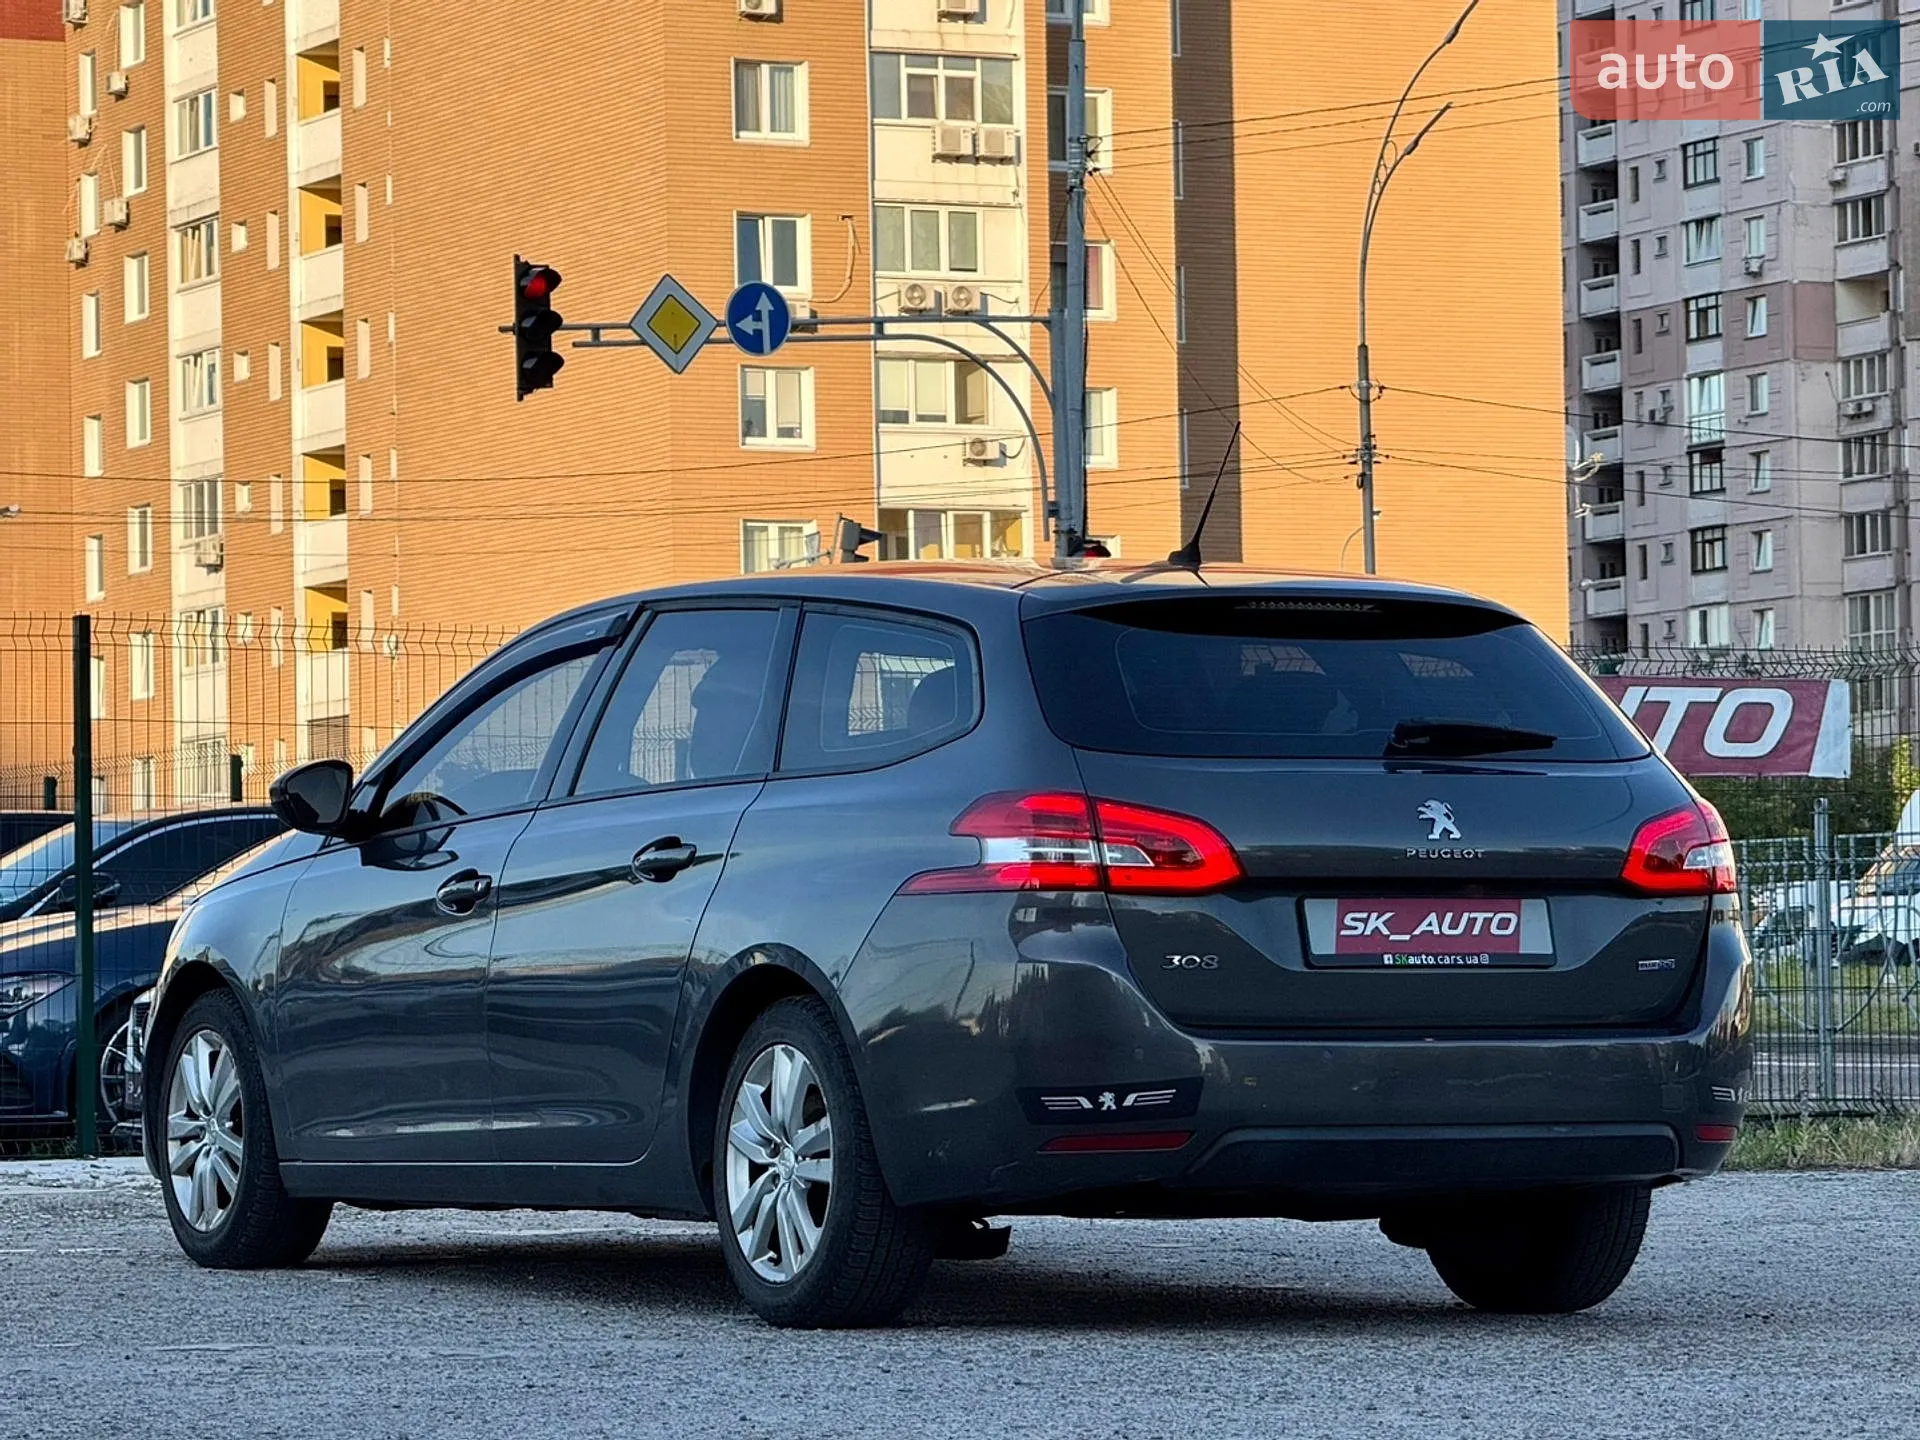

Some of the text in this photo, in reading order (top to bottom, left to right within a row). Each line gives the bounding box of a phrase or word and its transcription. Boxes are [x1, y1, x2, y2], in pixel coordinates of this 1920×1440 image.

[1618, 685, 1795, 758] TO
[1406, 847, 1485, 859] PEUGEOT
[1340, 911, 1518, 941] SK_AUTO
[1161, 954, 1219, 969] 308
